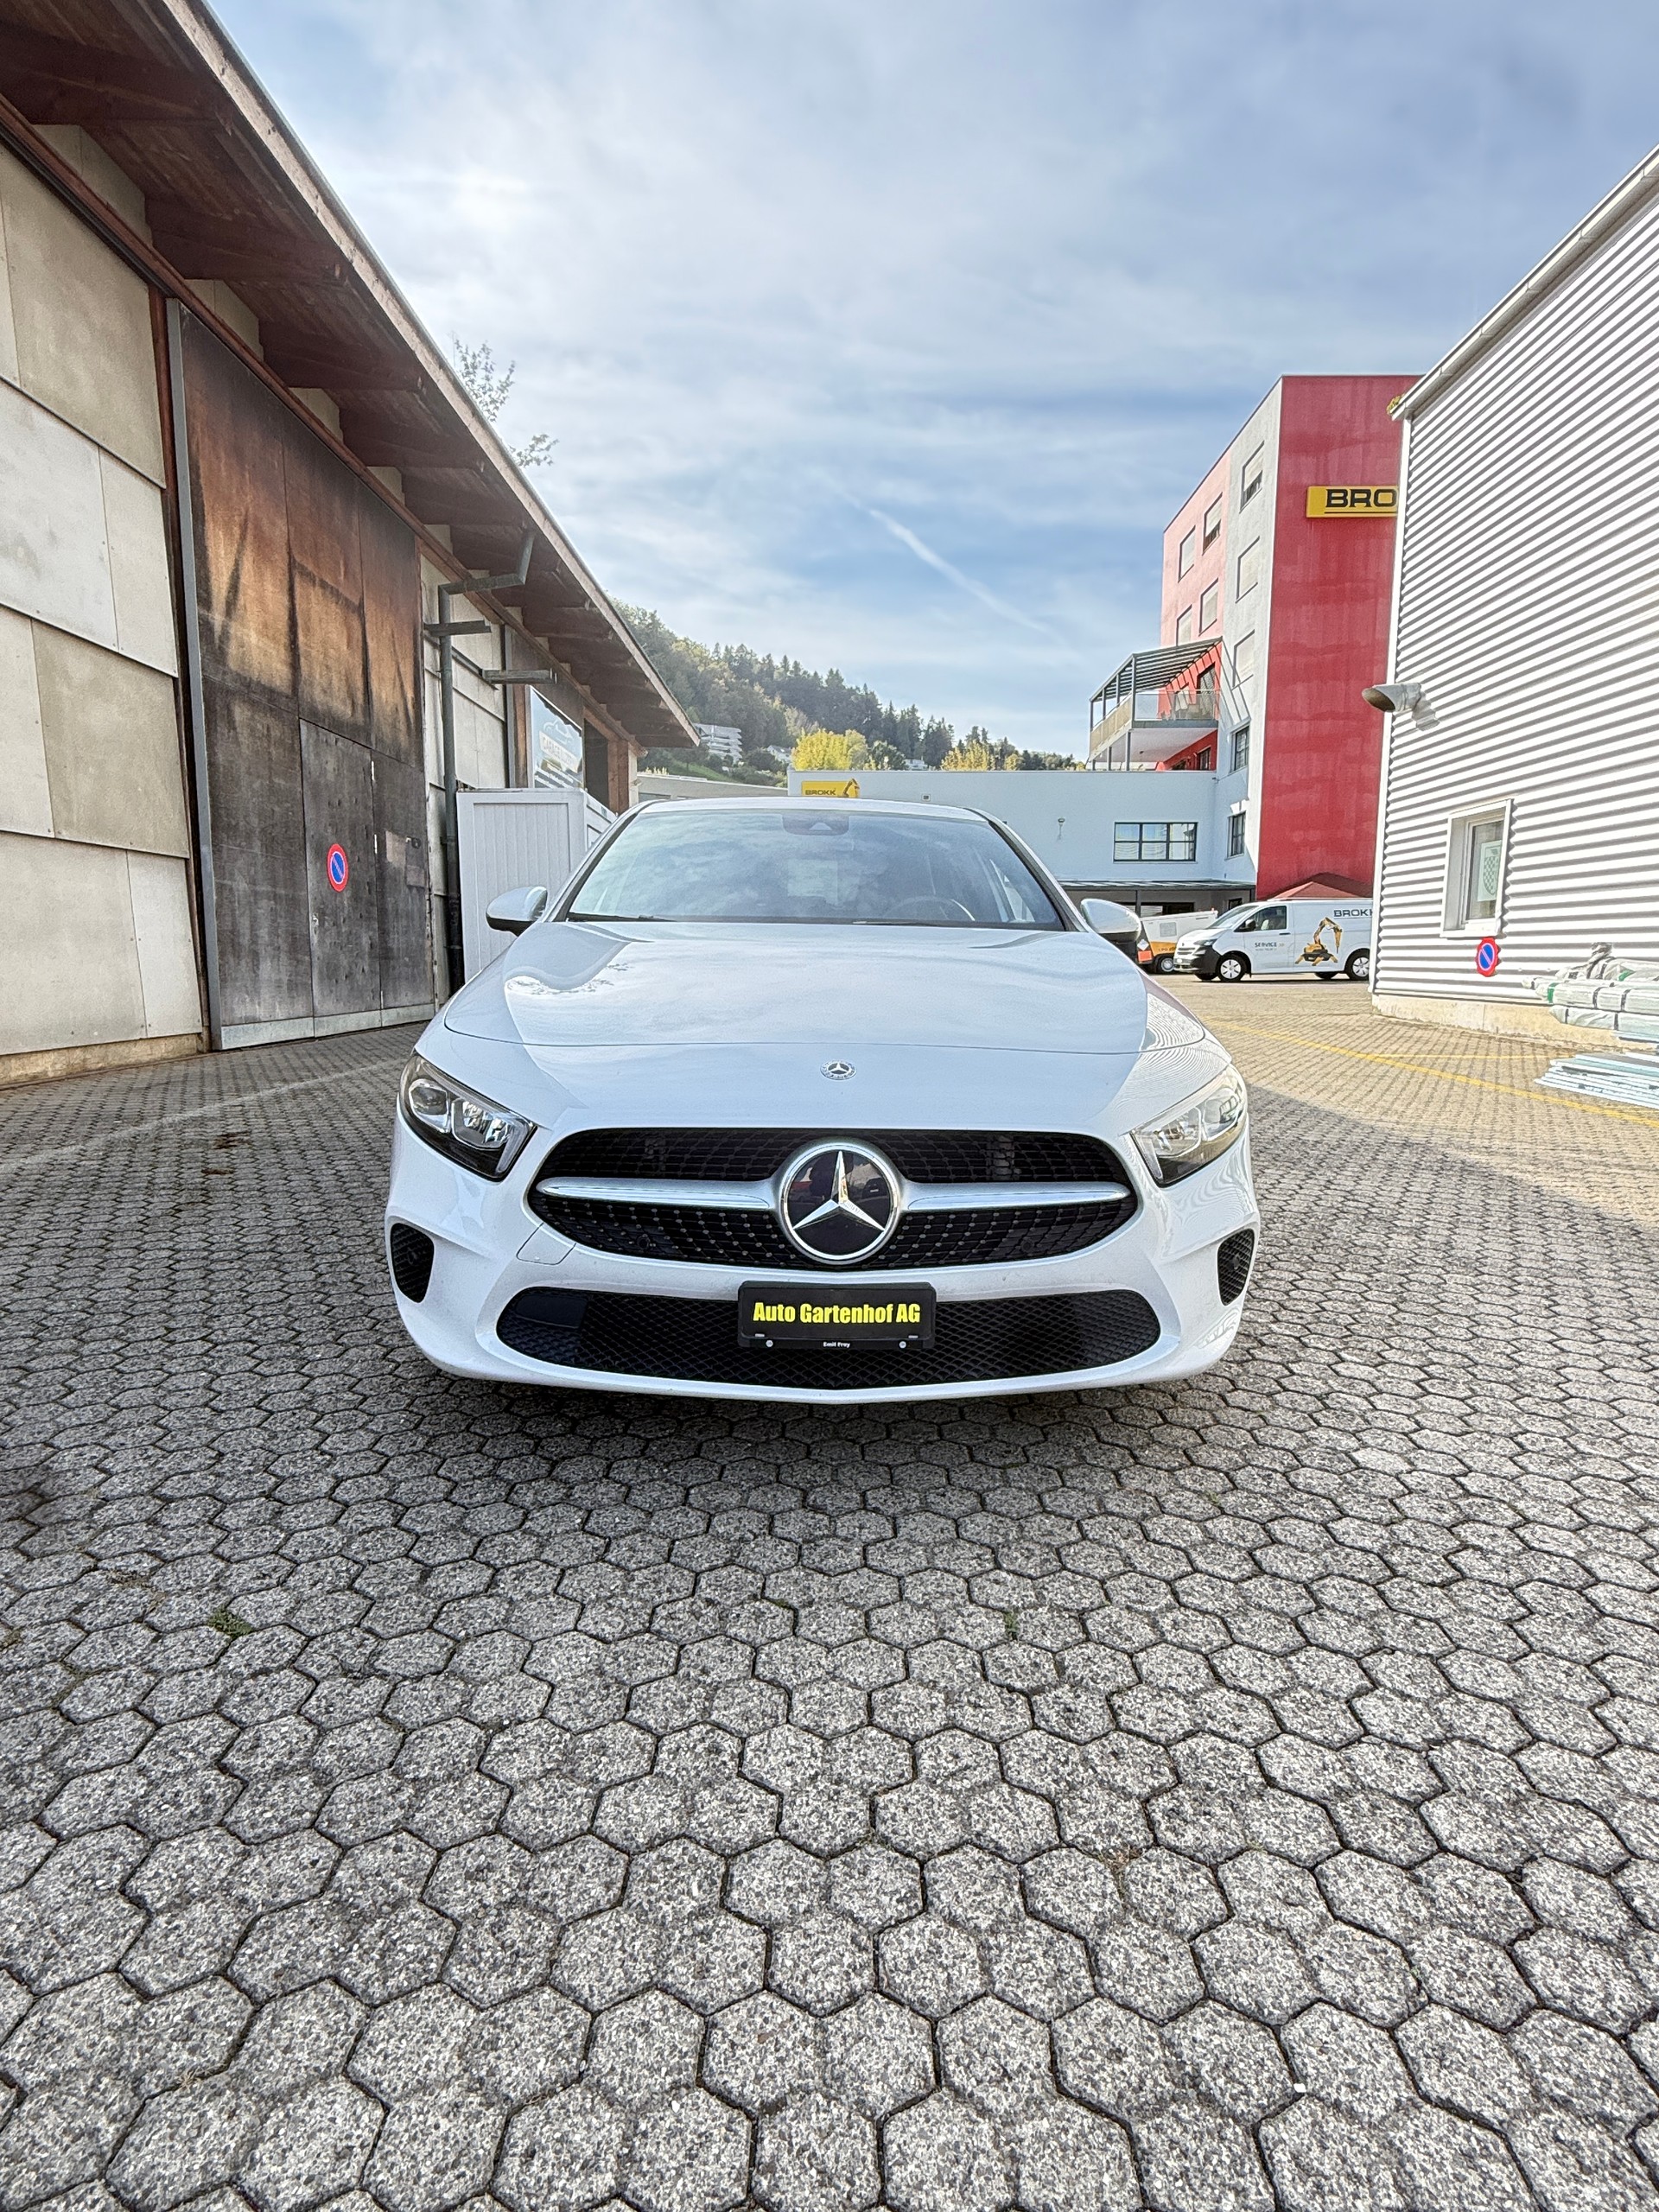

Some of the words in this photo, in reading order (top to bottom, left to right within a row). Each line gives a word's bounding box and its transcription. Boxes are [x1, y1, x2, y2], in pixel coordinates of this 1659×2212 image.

[1325, 488, 1397, 508] BRO
[753, 1302, 796, 1323] Auto
[799, 1303, 893, 1324] Gartenhof
[895, 1303, 921, 1324] AG
